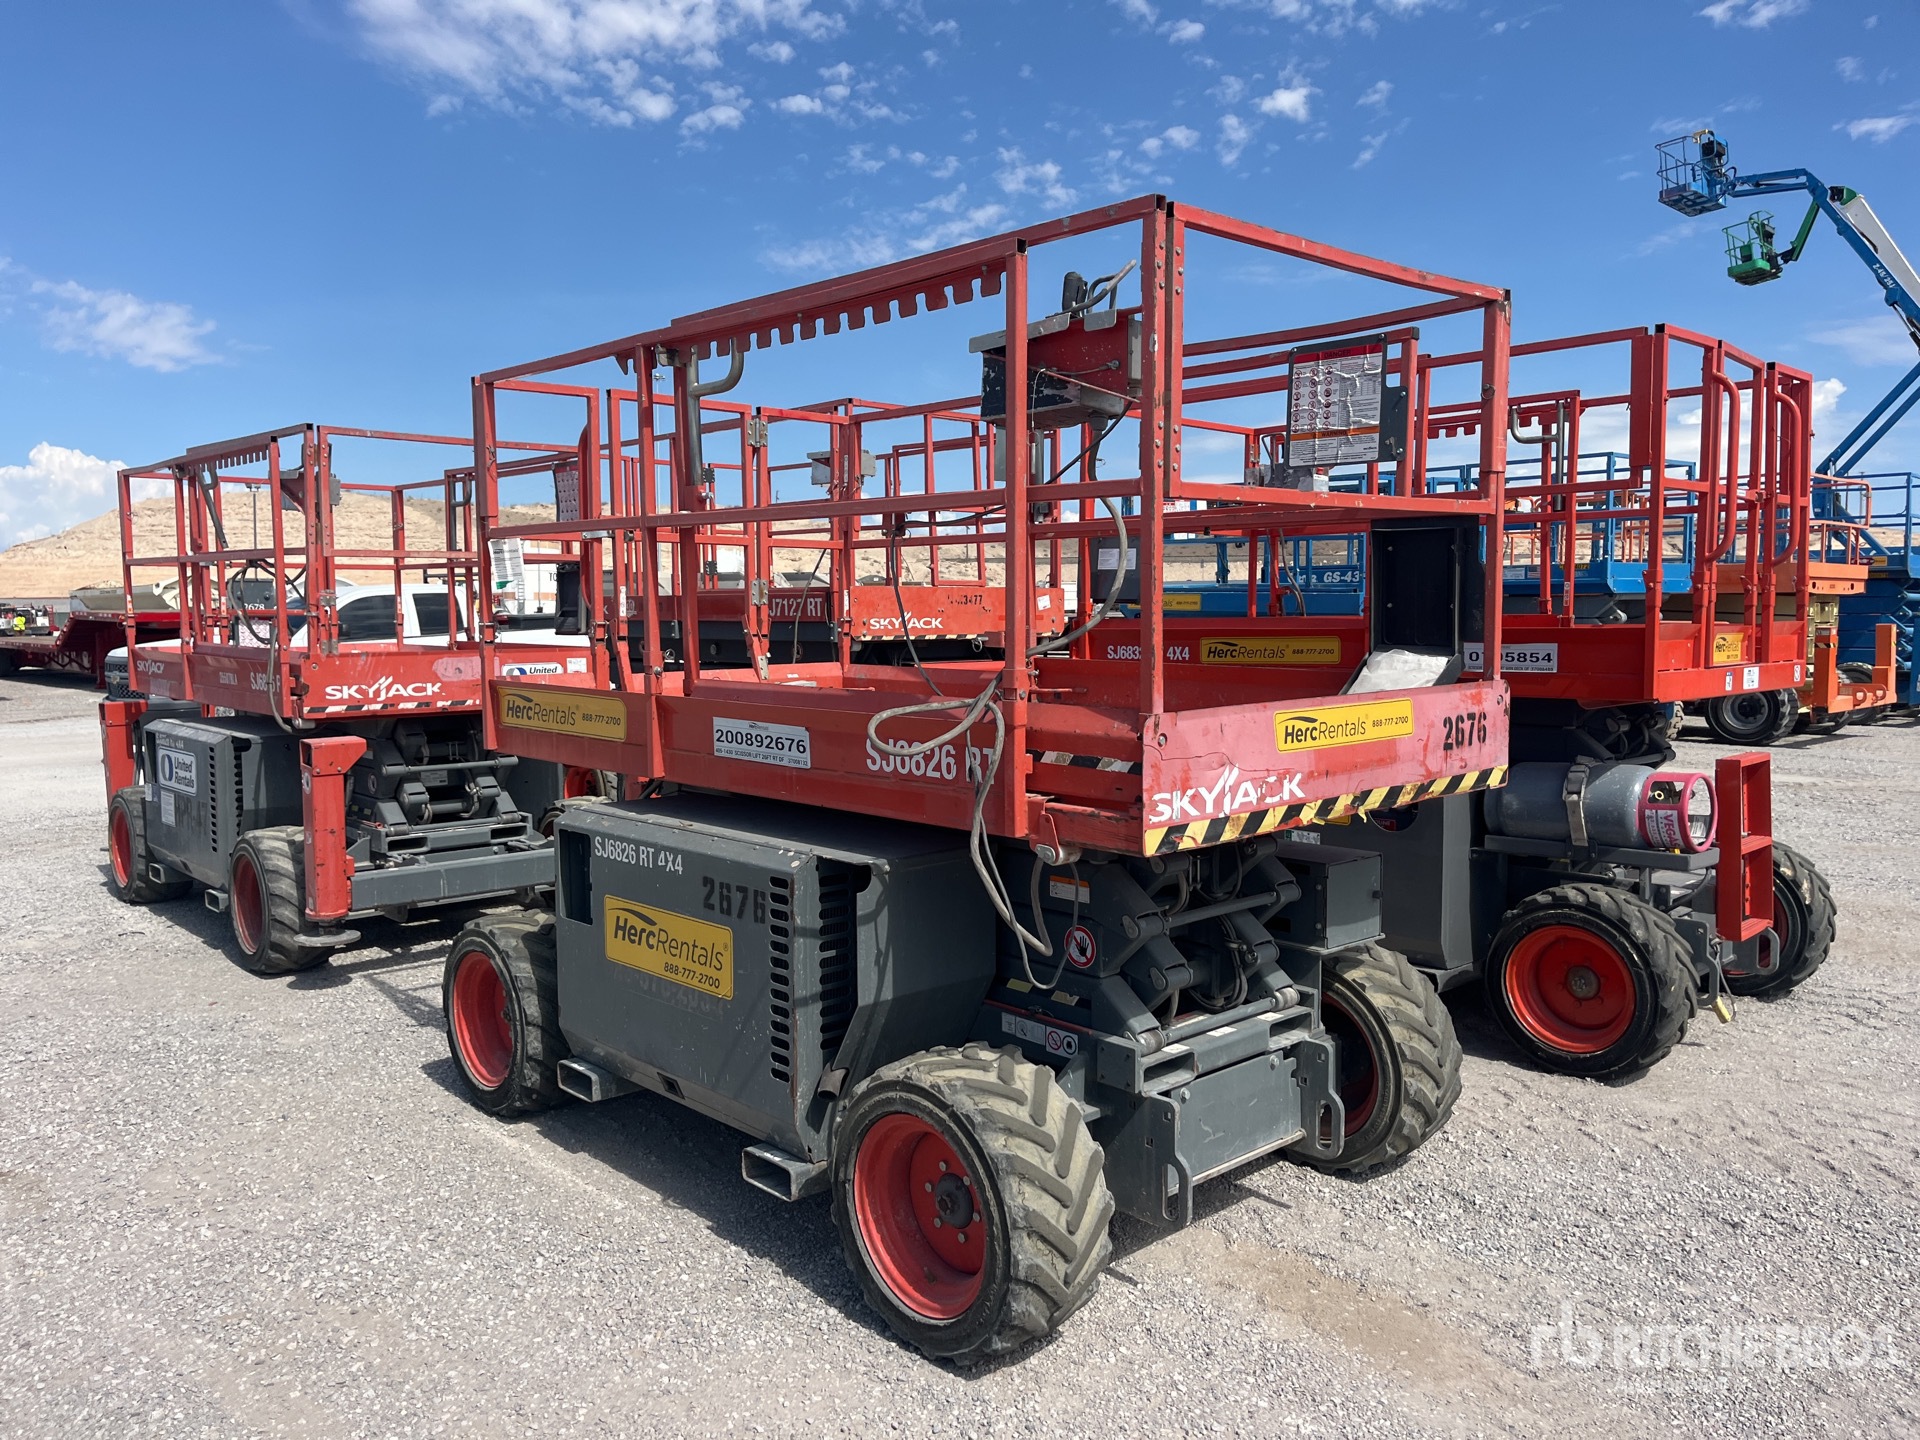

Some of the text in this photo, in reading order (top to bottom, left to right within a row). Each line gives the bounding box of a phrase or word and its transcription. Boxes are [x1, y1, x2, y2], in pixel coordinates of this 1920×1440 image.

[1323, 571, 1360, 583] GS-43
[769, 597, 822, 617] J7127 RT
[869, 611, 944, 632] SKYJACK
[1166, 646, 1190, 661] 4X4
[1206, 643, 1335, 659] HercRentals 888-777-2700
[1468, 651, 1553, 663] 05854
[529, 666, 558, 674] United
[324, 675, 446, 702] SKYJACK
[506, 699, 621, 727] HercRentals 888-777-2700
[715, 728, 807, 754] 200892676
[1283, 715, 1409, 745] HercRentals 888-777-2700
[1442, 711, 1487, 751] 2676
[174, 756, 193, 774] United
[174, 771, 195, 788] Rentals
[1149, 762, 1306, 823] SKYJACK
[594, 836, 684, 875] SJ6826 RT 4X4
[702, 875, 767, 925] 2676
[613, 915, 725, 972] HercRentals
[663, 961, 721, 990] 888-777-2700
